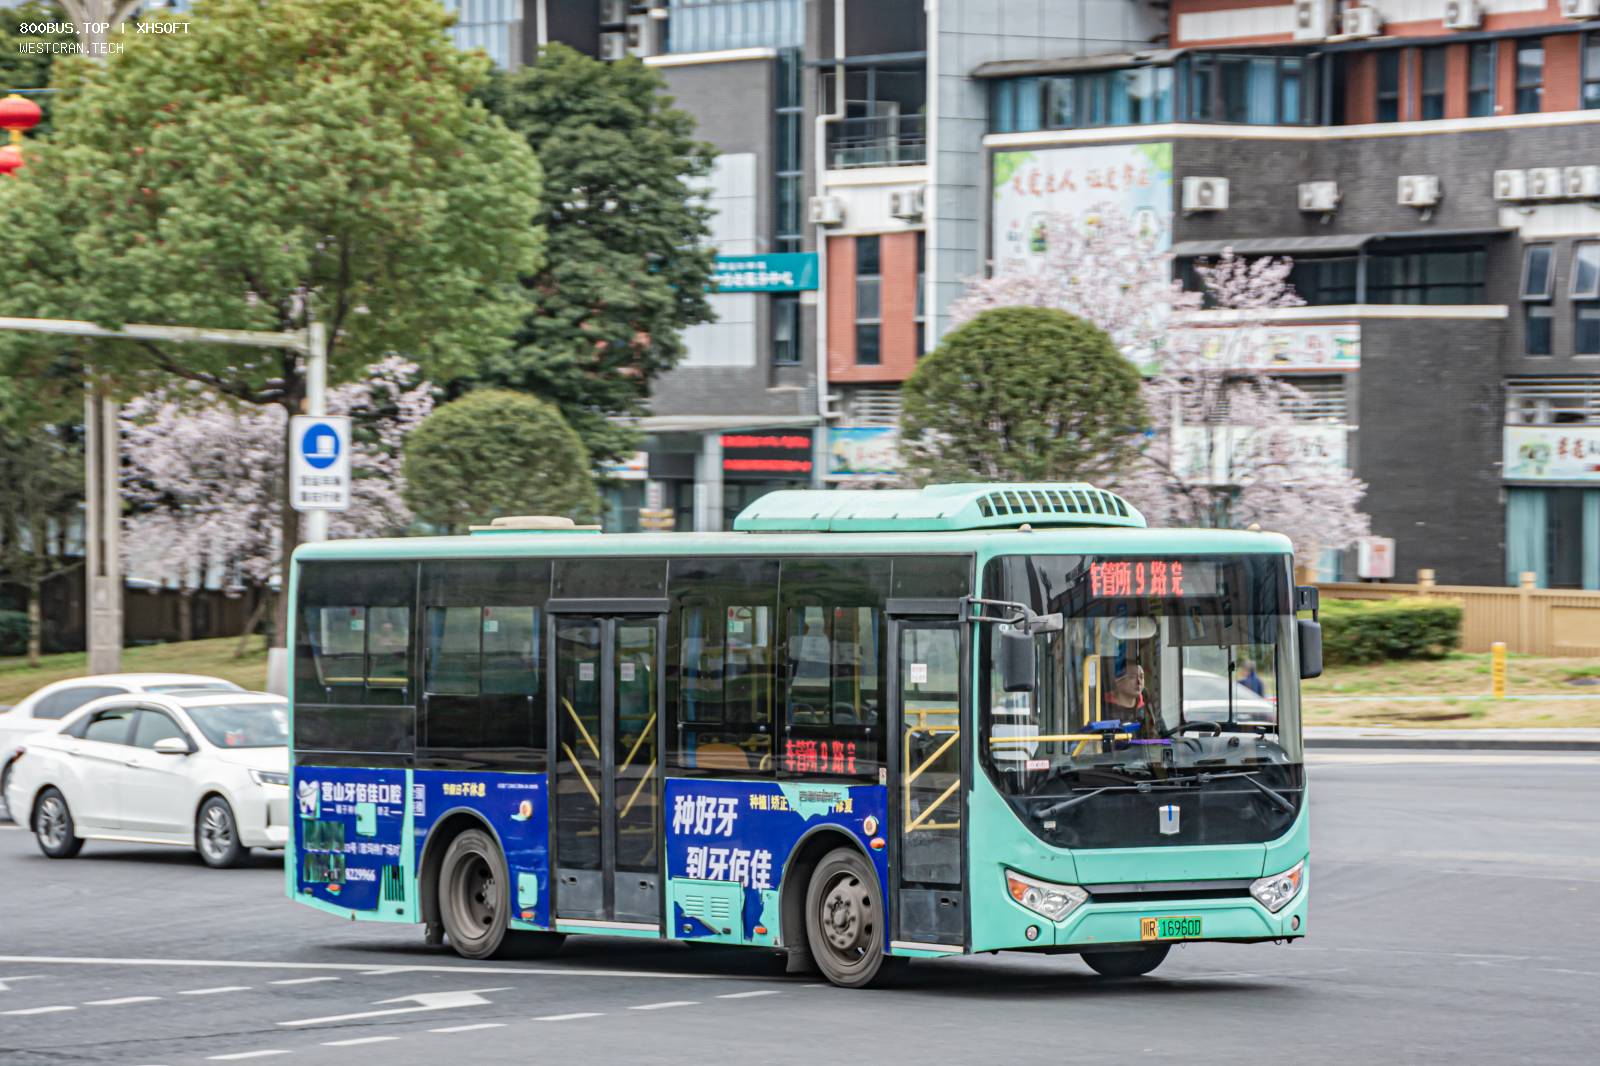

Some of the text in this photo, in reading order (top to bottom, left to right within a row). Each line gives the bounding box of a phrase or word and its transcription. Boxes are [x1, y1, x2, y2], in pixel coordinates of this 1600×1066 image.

[321, 781, 402, 804] 营山牙佰佳口腔
[672, 794, 739, 837] 种好牙
[686, 846, 773, 889] 到牙佰佳
